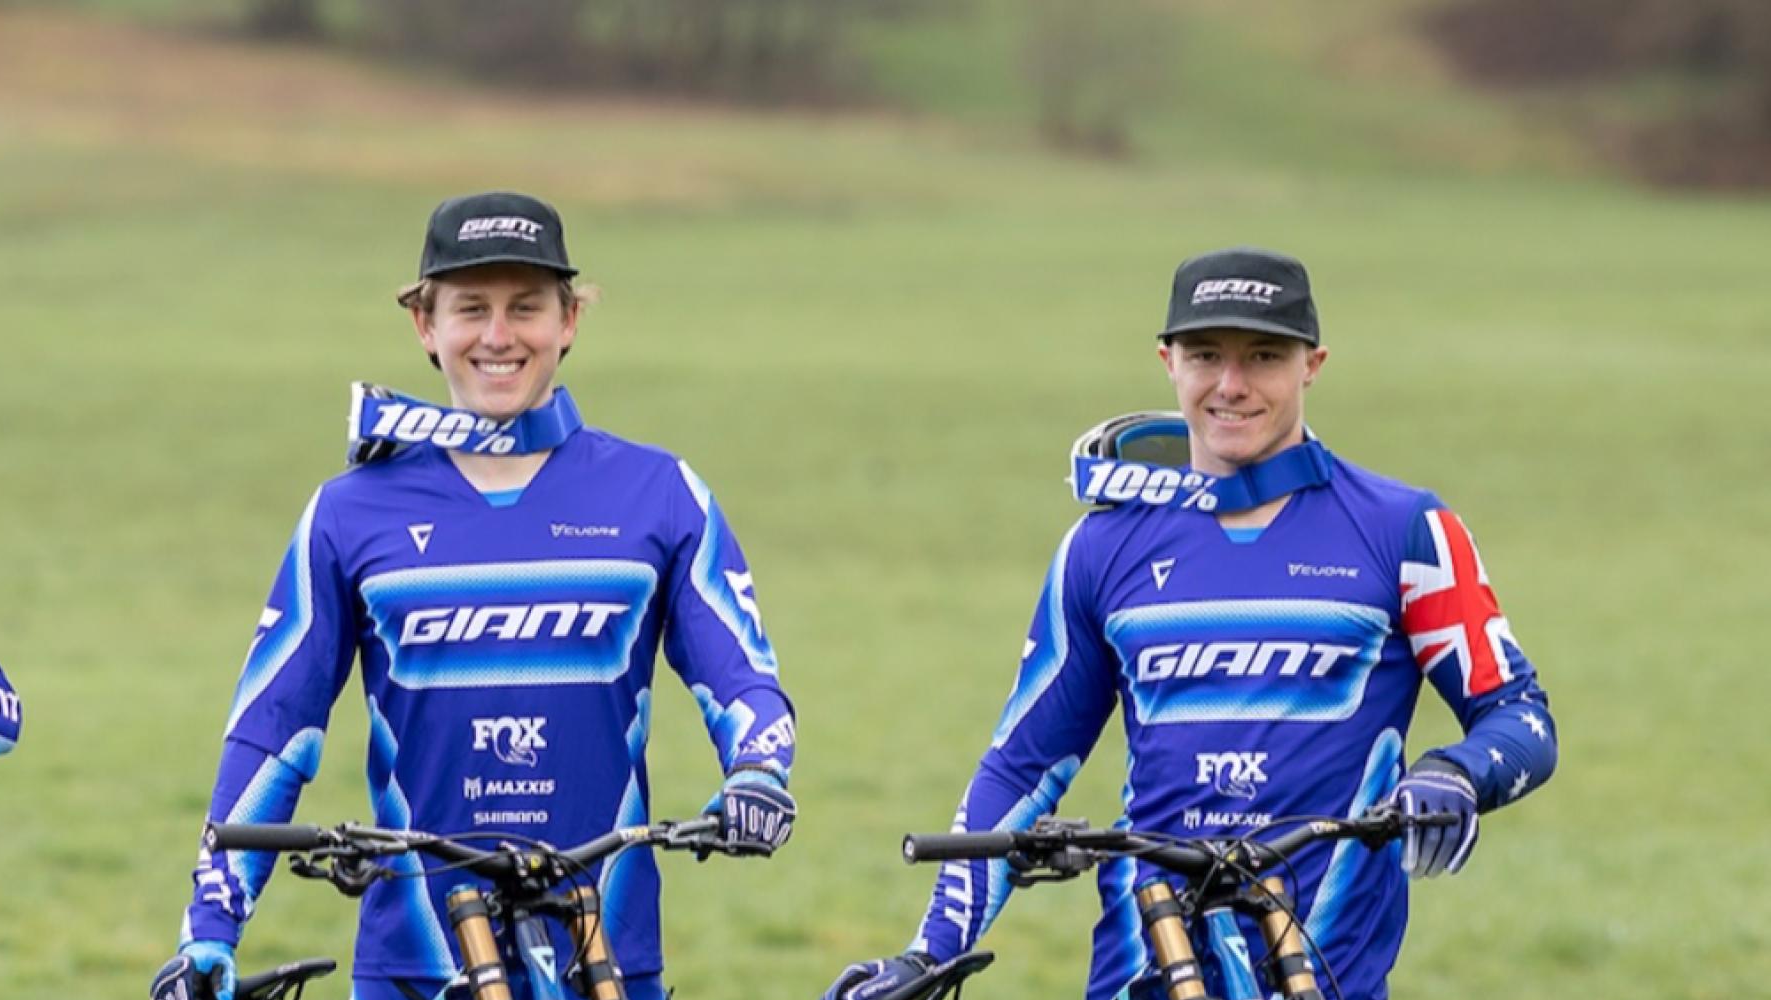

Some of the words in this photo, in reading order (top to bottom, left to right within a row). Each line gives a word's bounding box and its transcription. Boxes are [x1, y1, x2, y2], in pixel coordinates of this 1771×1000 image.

[459, 216, 543, 233] GIANT
[1193, 278, 1283, 297] GIANT
[371, 403, 516, 454] 100%
[1085, 461, 1219, 511] 100%
[399, 602, 631, 646] GIANT
[1137, 641, 1361, 682] GIANT
[472, 716, 548, 767] FOX
[485, 779, 556, 796] MAXXIS
[1196, 752, 1268, 800] FOX
[1203, 811, 1273, 826] MAXXIS
